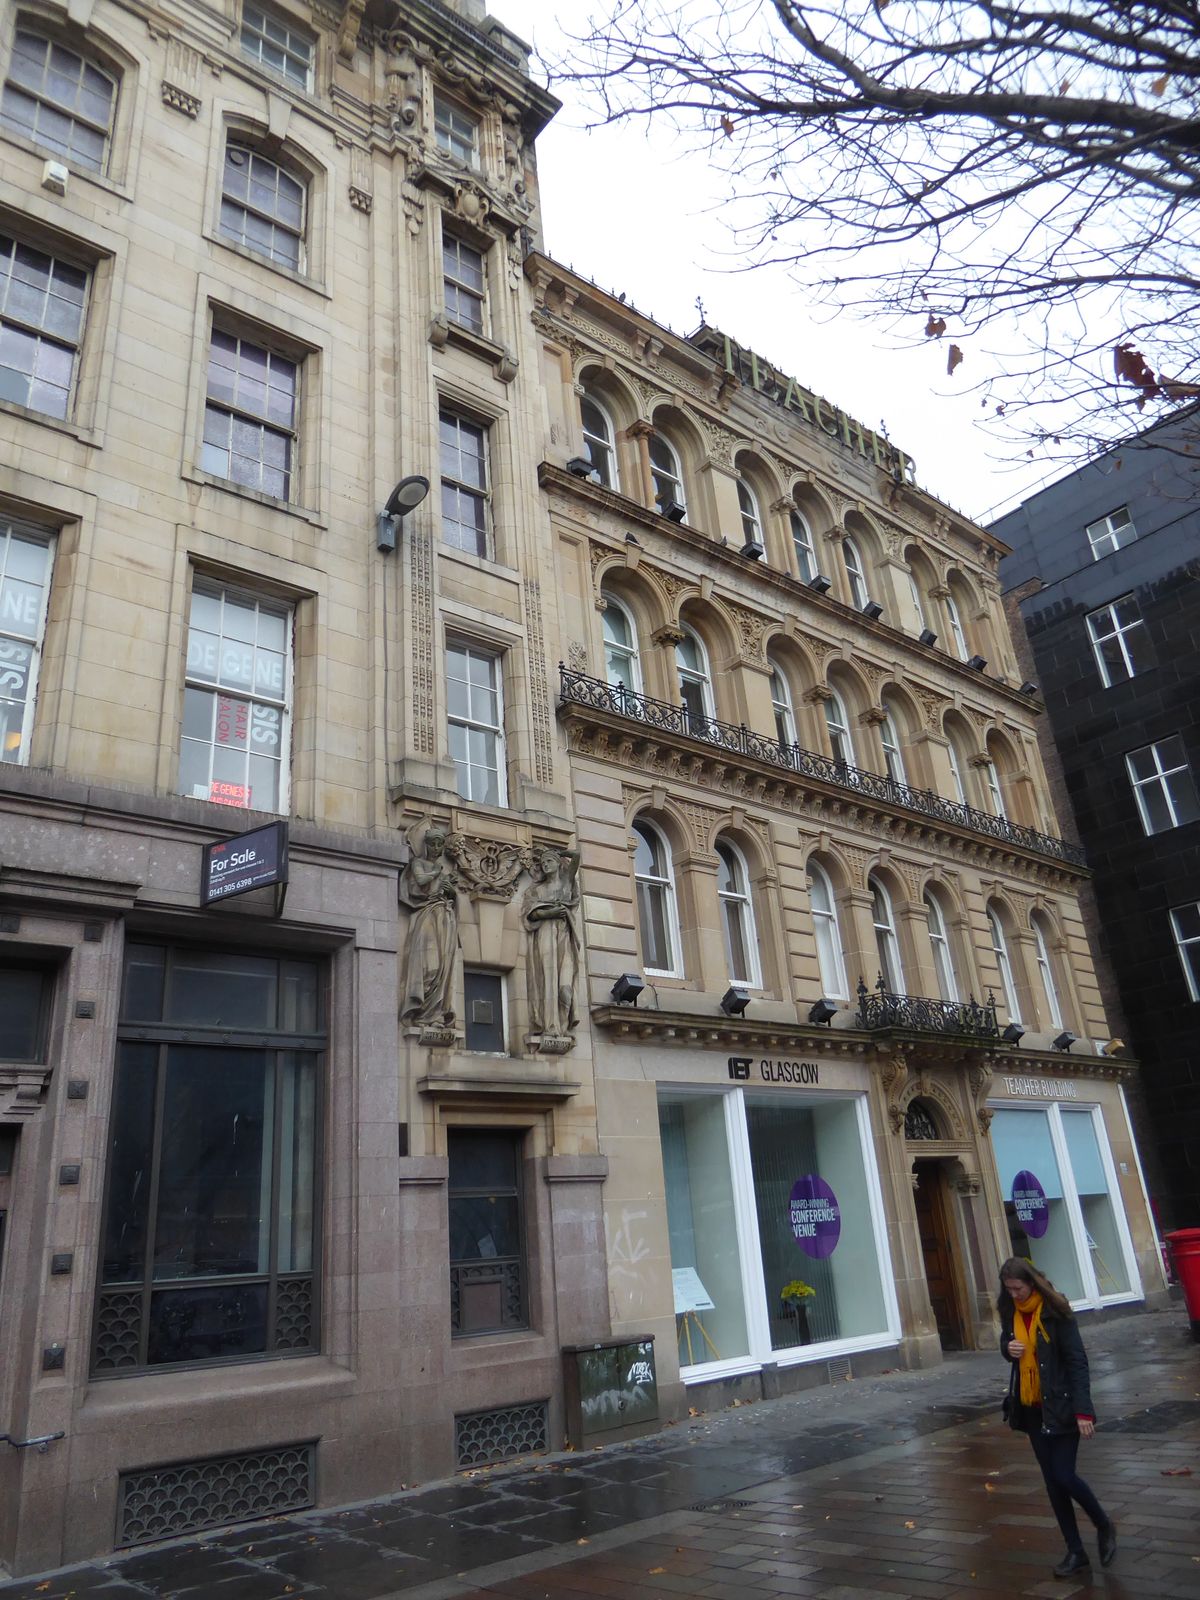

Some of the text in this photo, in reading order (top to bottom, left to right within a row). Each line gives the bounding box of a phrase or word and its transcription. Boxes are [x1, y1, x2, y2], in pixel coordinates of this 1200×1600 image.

[713, 326, 922, 495] TEACHER
[190, 640, 283, 688] DE GENE
[234, 704, 248, 740] HAIR
[251, 703, 280, 745] SIS
[210, 859, 229, 874] For
[230, 848, 256, 867] Sale
[209, 887, 223, 897] 0141
[223, 882, 236, 893] 305
[236, 878, 252, 889] 6398
[760, 1060, 819, 1084] GLASGOW
[1003, 1077, 1076, 1098] TEACHER BUILDING
[791, 1208, 836, 1224] CONFERENCE
[792, 1223, 817, 1238] VENUE
